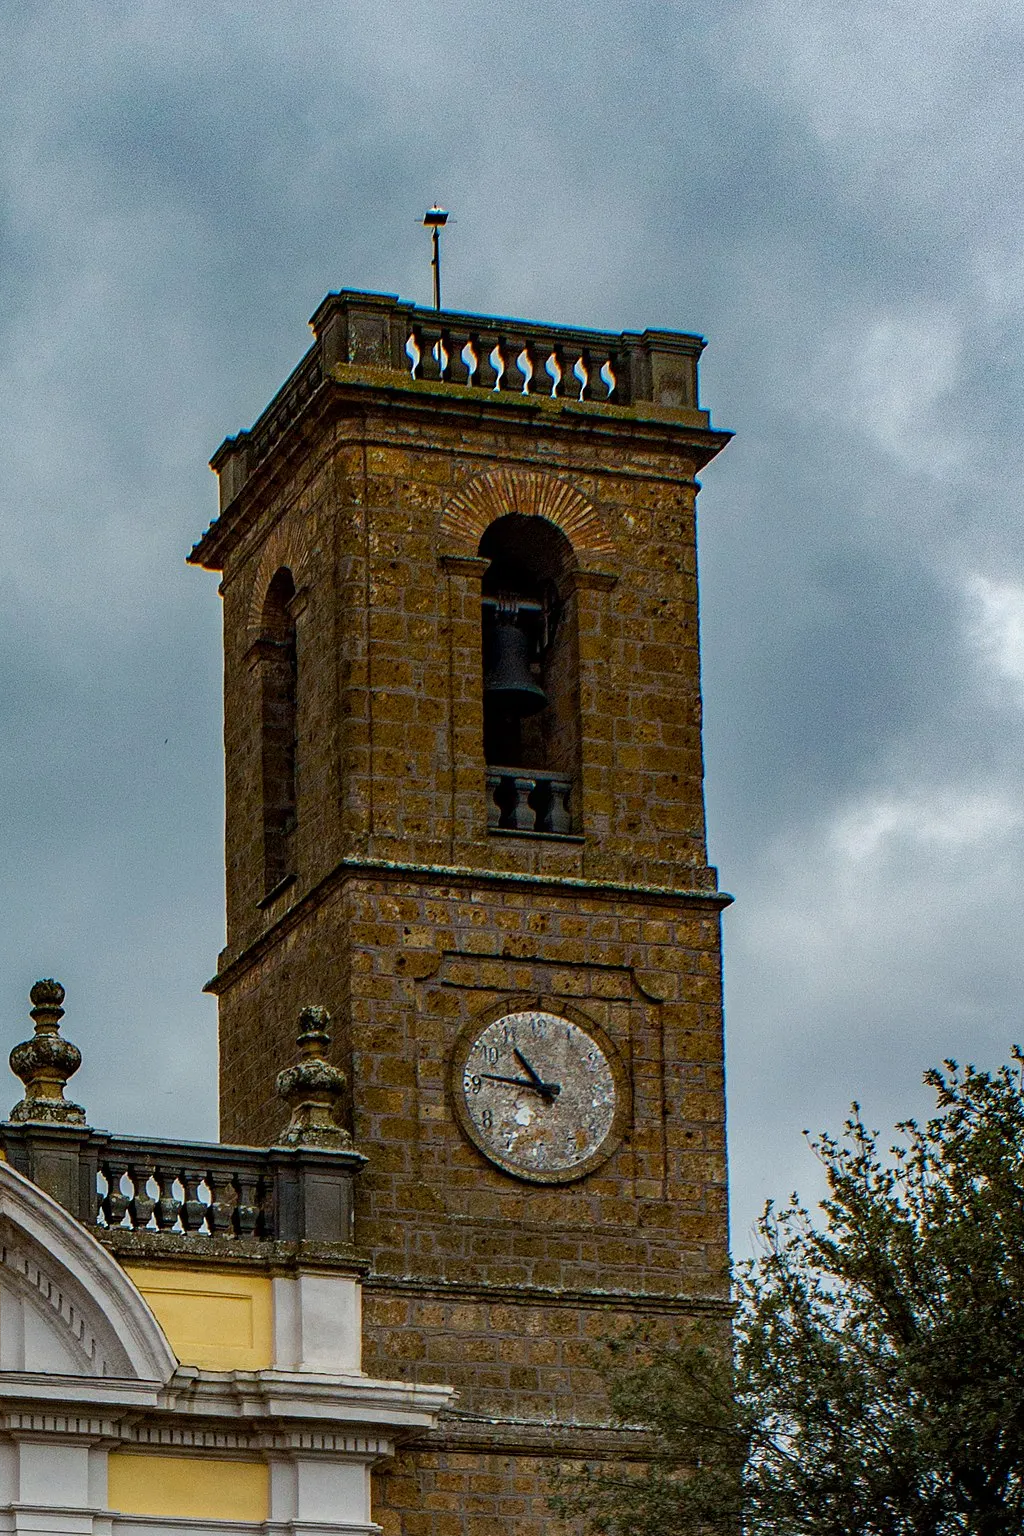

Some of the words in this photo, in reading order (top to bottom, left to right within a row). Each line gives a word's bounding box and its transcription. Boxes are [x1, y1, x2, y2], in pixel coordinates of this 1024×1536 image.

[482, 1046, 499, 1065] 10
[471, 1075, 481, 1095] 9
[482, 1109, 493, 1129] 8
